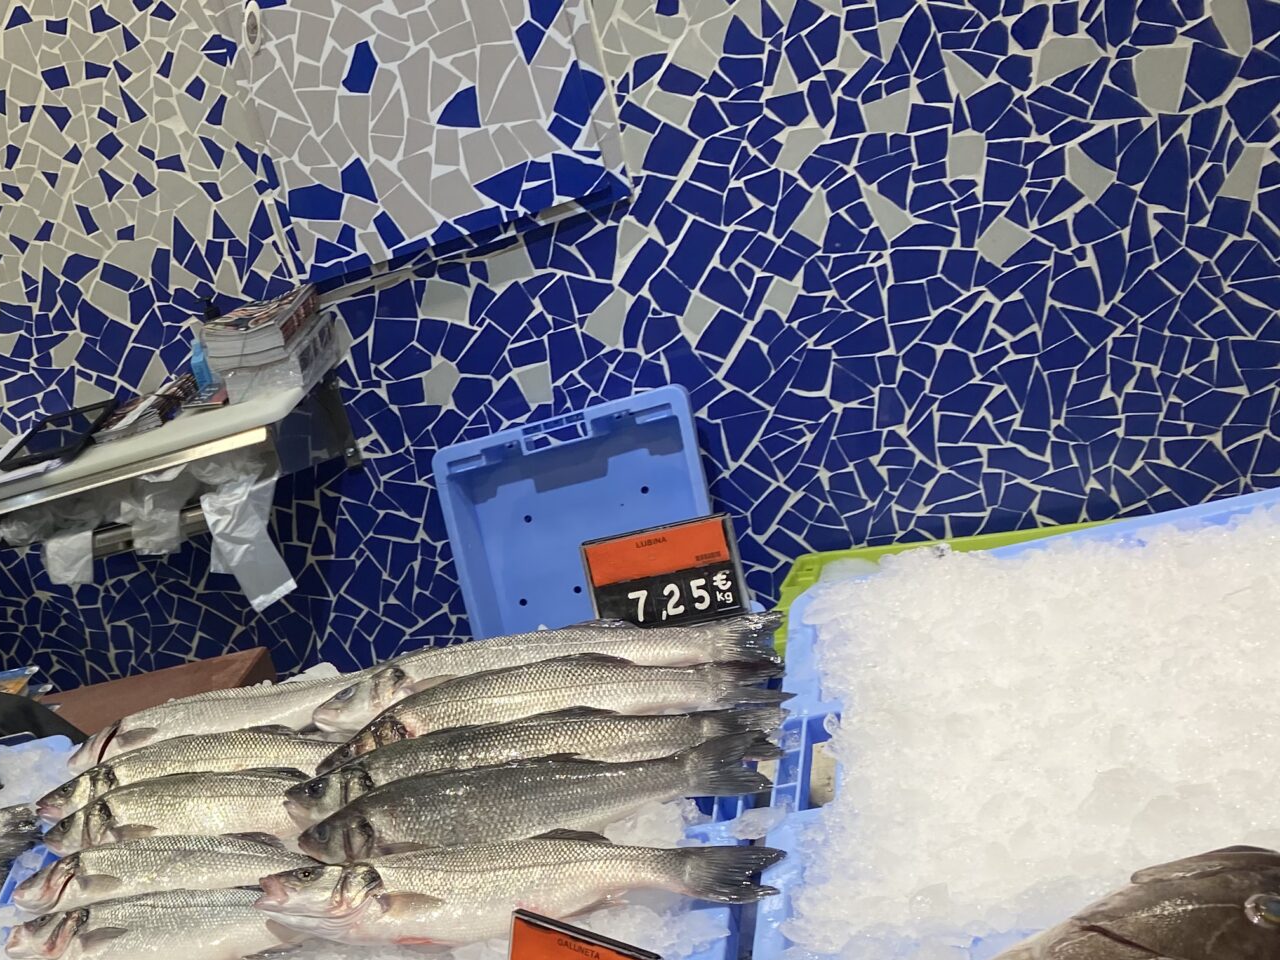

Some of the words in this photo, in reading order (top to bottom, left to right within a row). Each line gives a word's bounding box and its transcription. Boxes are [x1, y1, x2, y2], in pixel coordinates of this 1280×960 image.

[636, 536, 668, 549] LUBINA
[627, 578, 711, 623] 7,25
[716, 590, 733, 604] kg
[557, 938, 601, 960] GALLINETA
